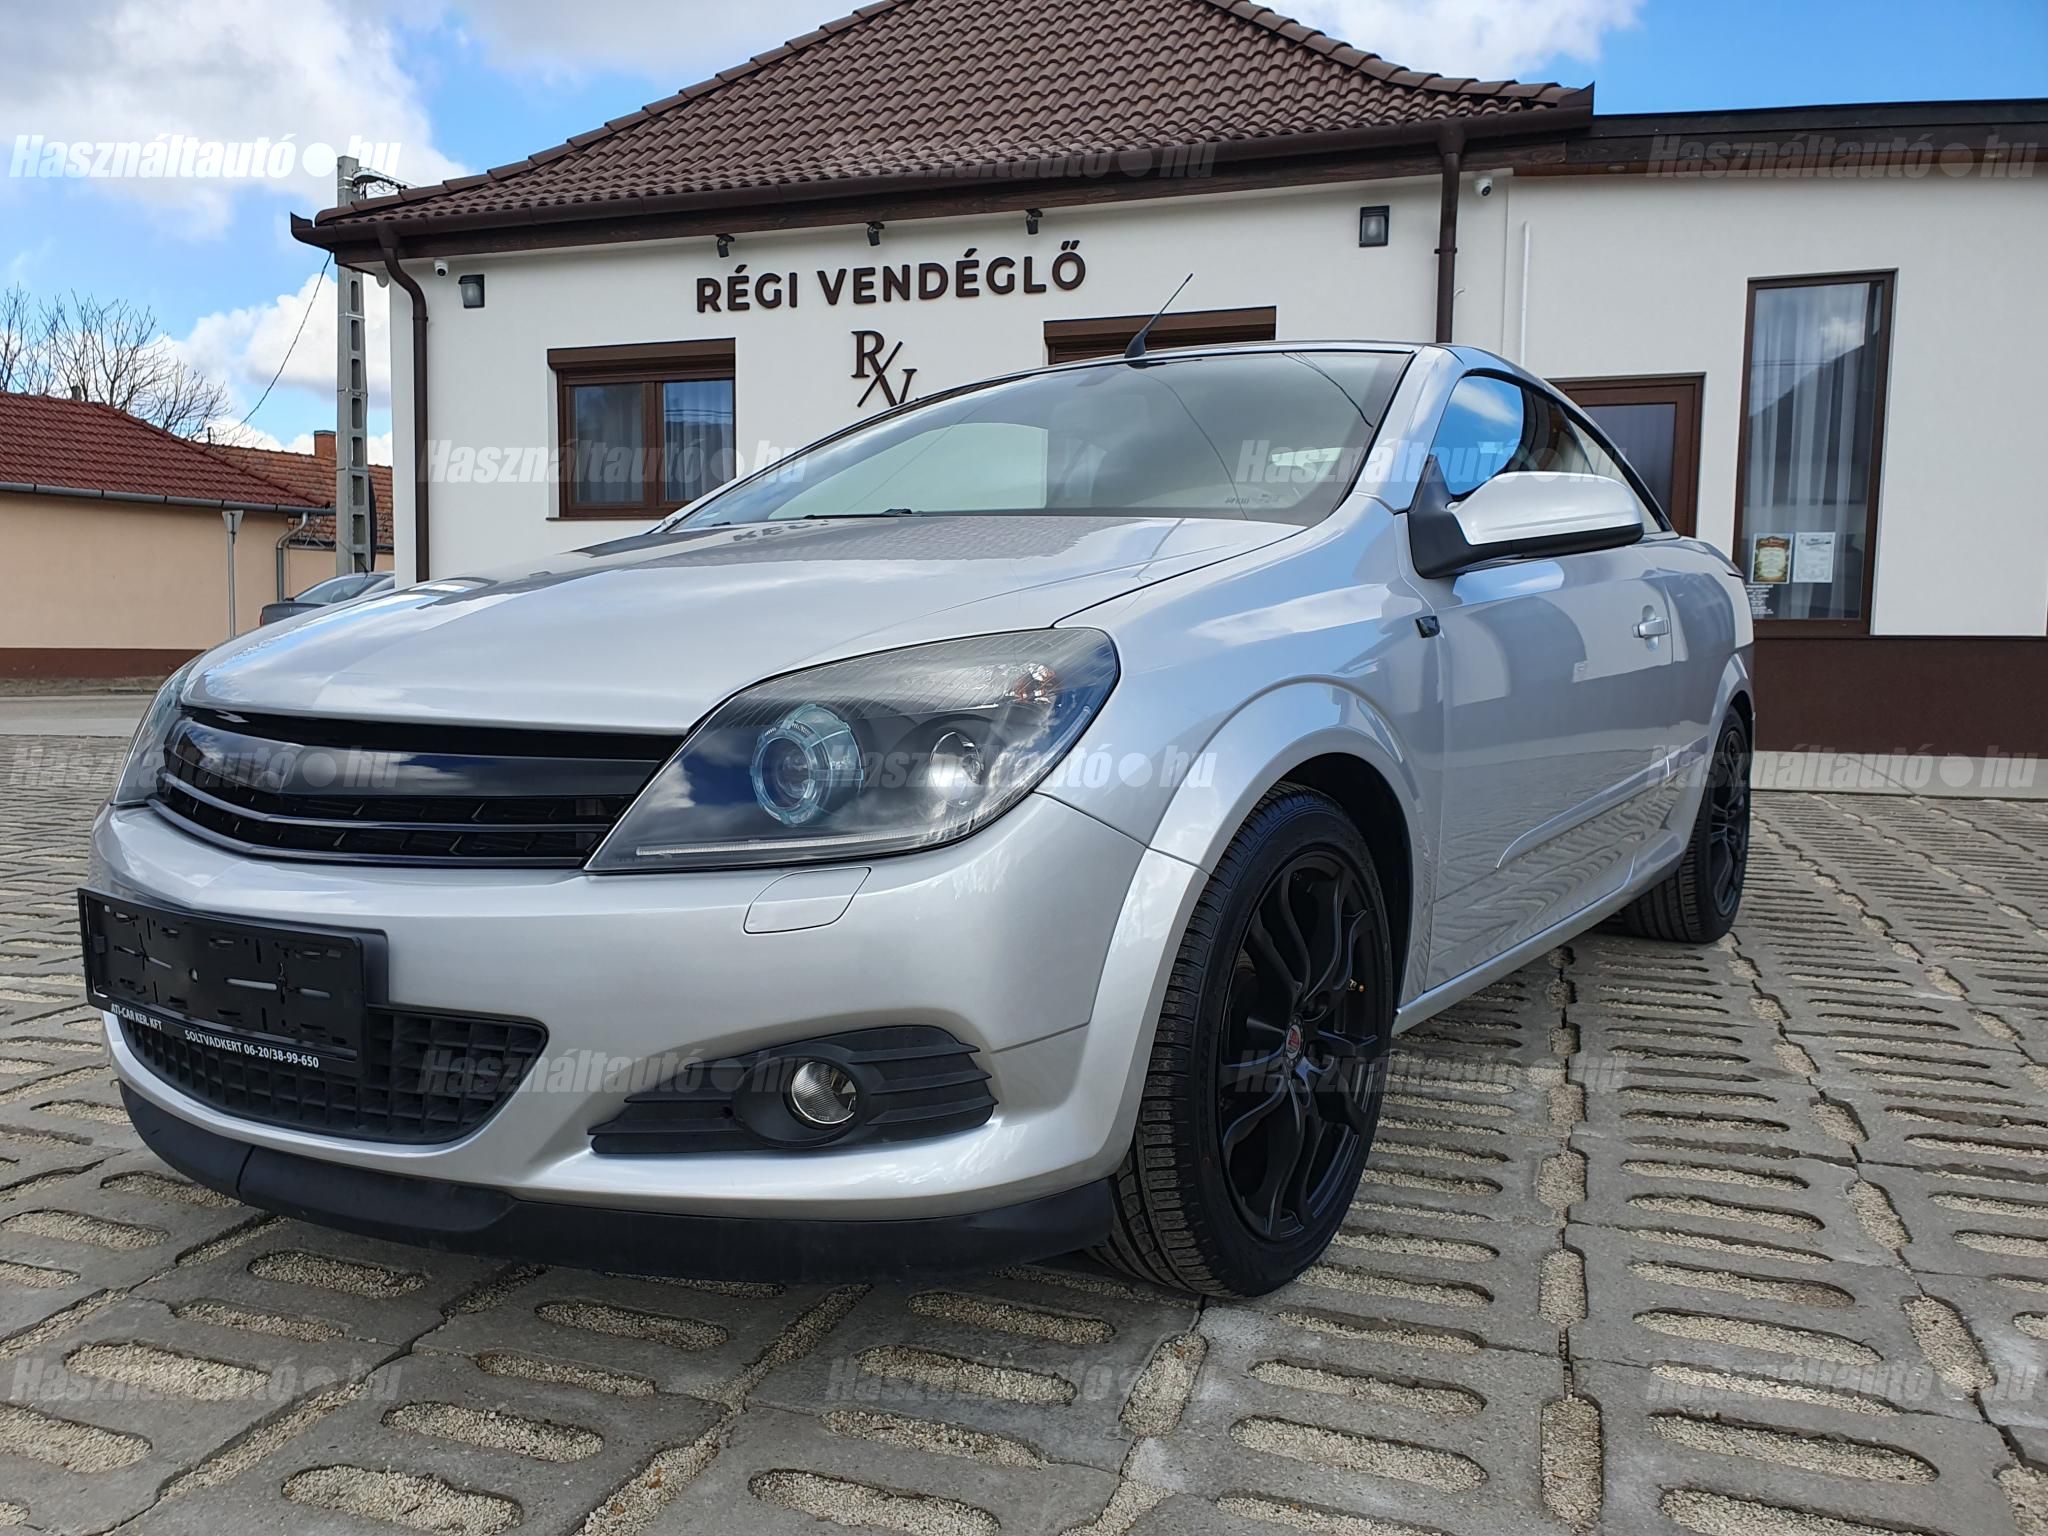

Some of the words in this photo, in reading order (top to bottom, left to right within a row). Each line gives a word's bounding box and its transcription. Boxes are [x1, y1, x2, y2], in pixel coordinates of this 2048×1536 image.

[696, 264, 798, 313] RÉGI
[816, 240, 1087, 306] VENDÉGLŐ
[111, 1003, 135, 1022] ATI-CAR
[149, 1018, 162, 1031] KFT
[184, 1029, 243, 1054] SOLTVADKERT
[243, 1043, 319, 1069] 06-20/38-99-650
